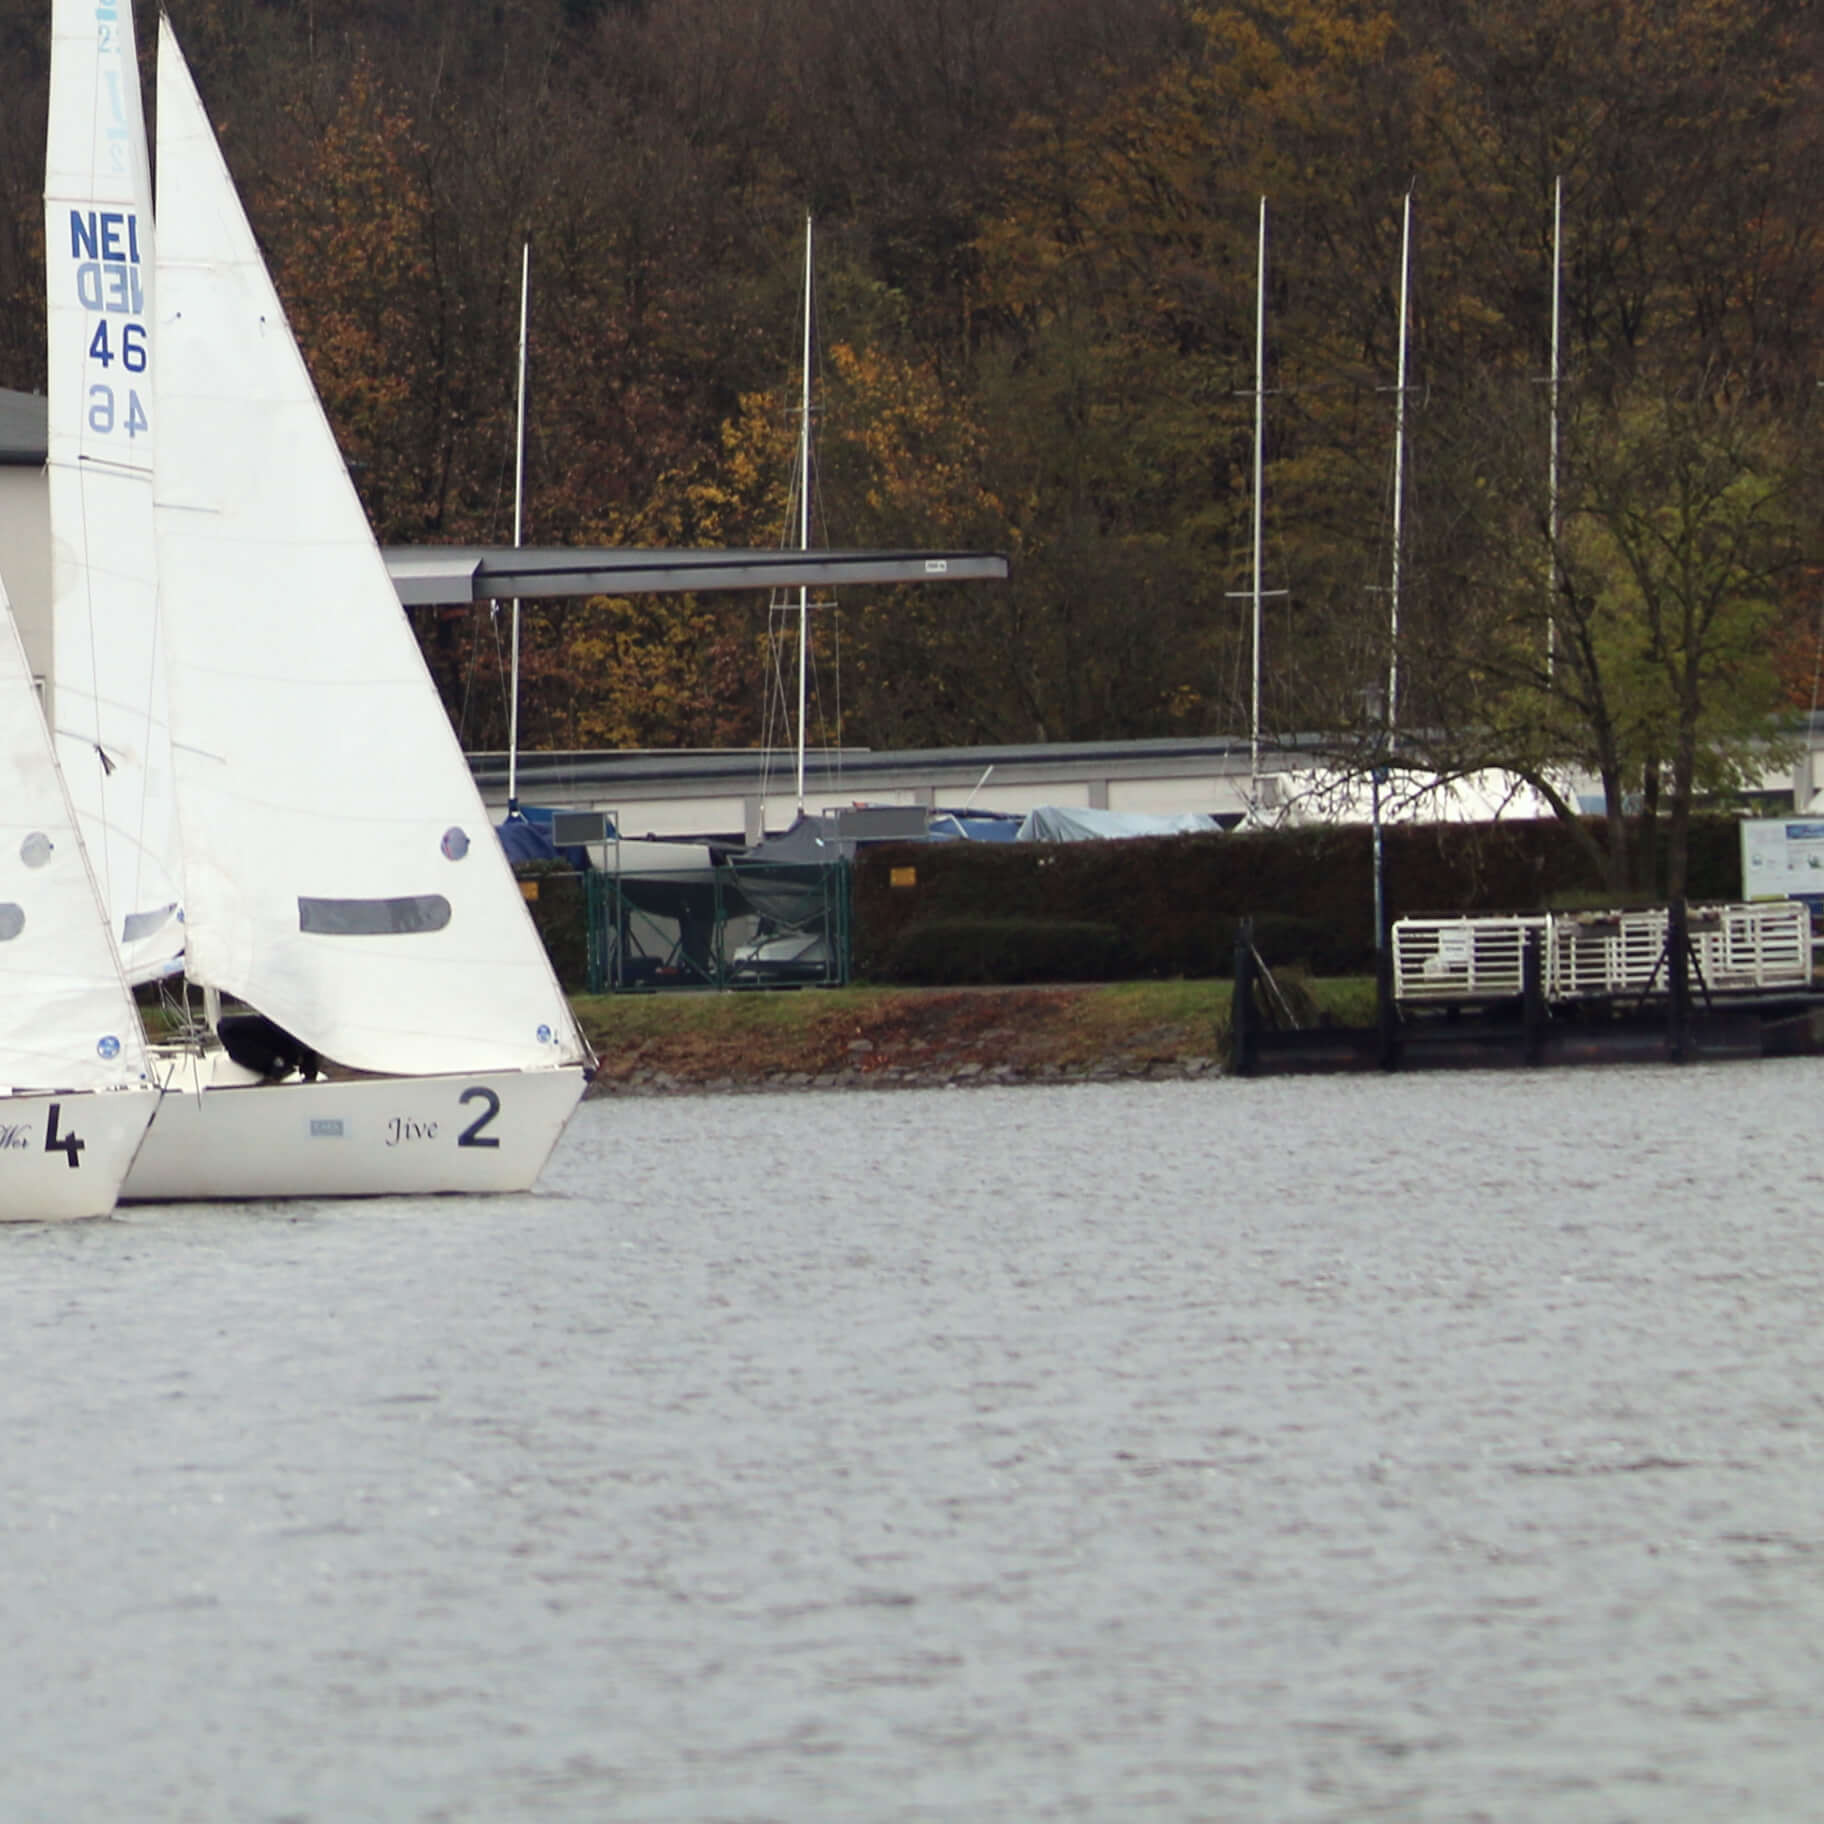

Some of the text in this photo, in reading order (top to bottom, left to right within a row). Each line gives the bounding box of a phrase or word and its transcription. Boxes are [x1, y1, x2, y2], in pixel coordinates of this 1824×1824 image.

[89, 319, 148, 374] 46
[44, 1103, 85, 1168] 4
[385, 1116, 439, 1147] Jive
[458, 1085, 501, 1149] 2
